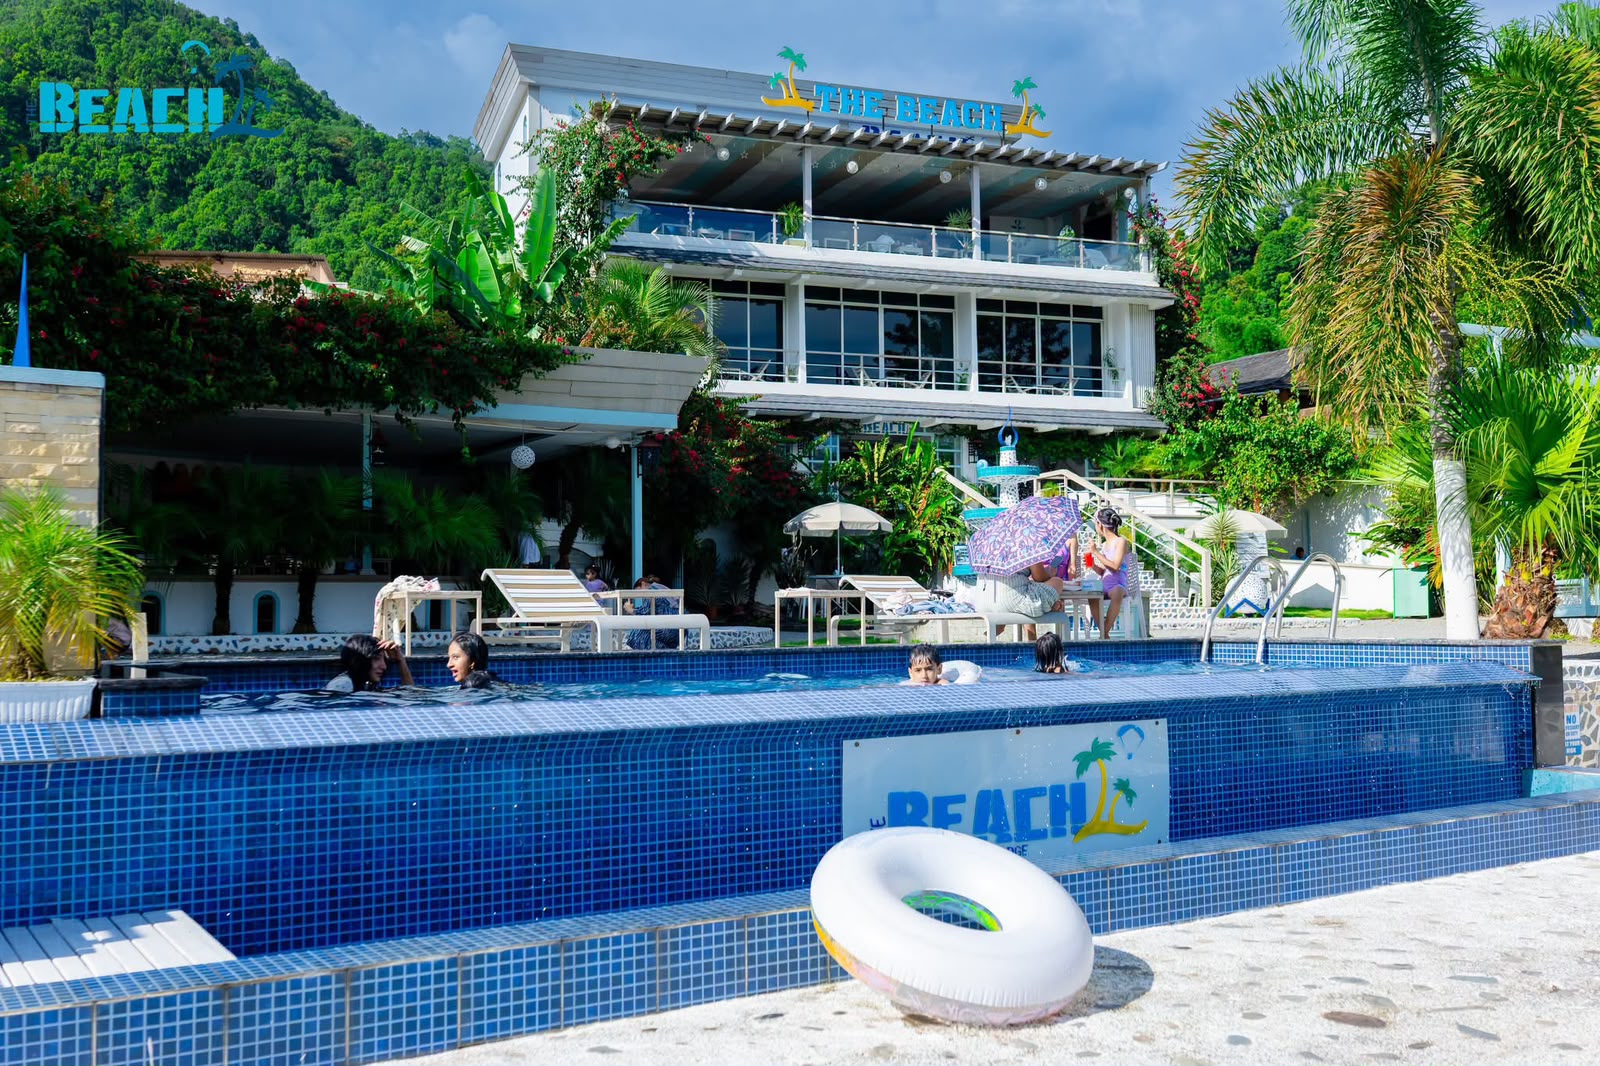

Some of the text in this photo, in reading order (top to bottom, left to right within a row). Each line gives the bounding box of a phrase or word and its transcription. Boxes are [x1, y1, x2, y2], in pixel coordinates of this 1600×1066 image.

[814, 84, 1004, 132] THE BEACH
[1566, 714, 1577, 724] NO
[887, 782, 1087, 844] BEACH
